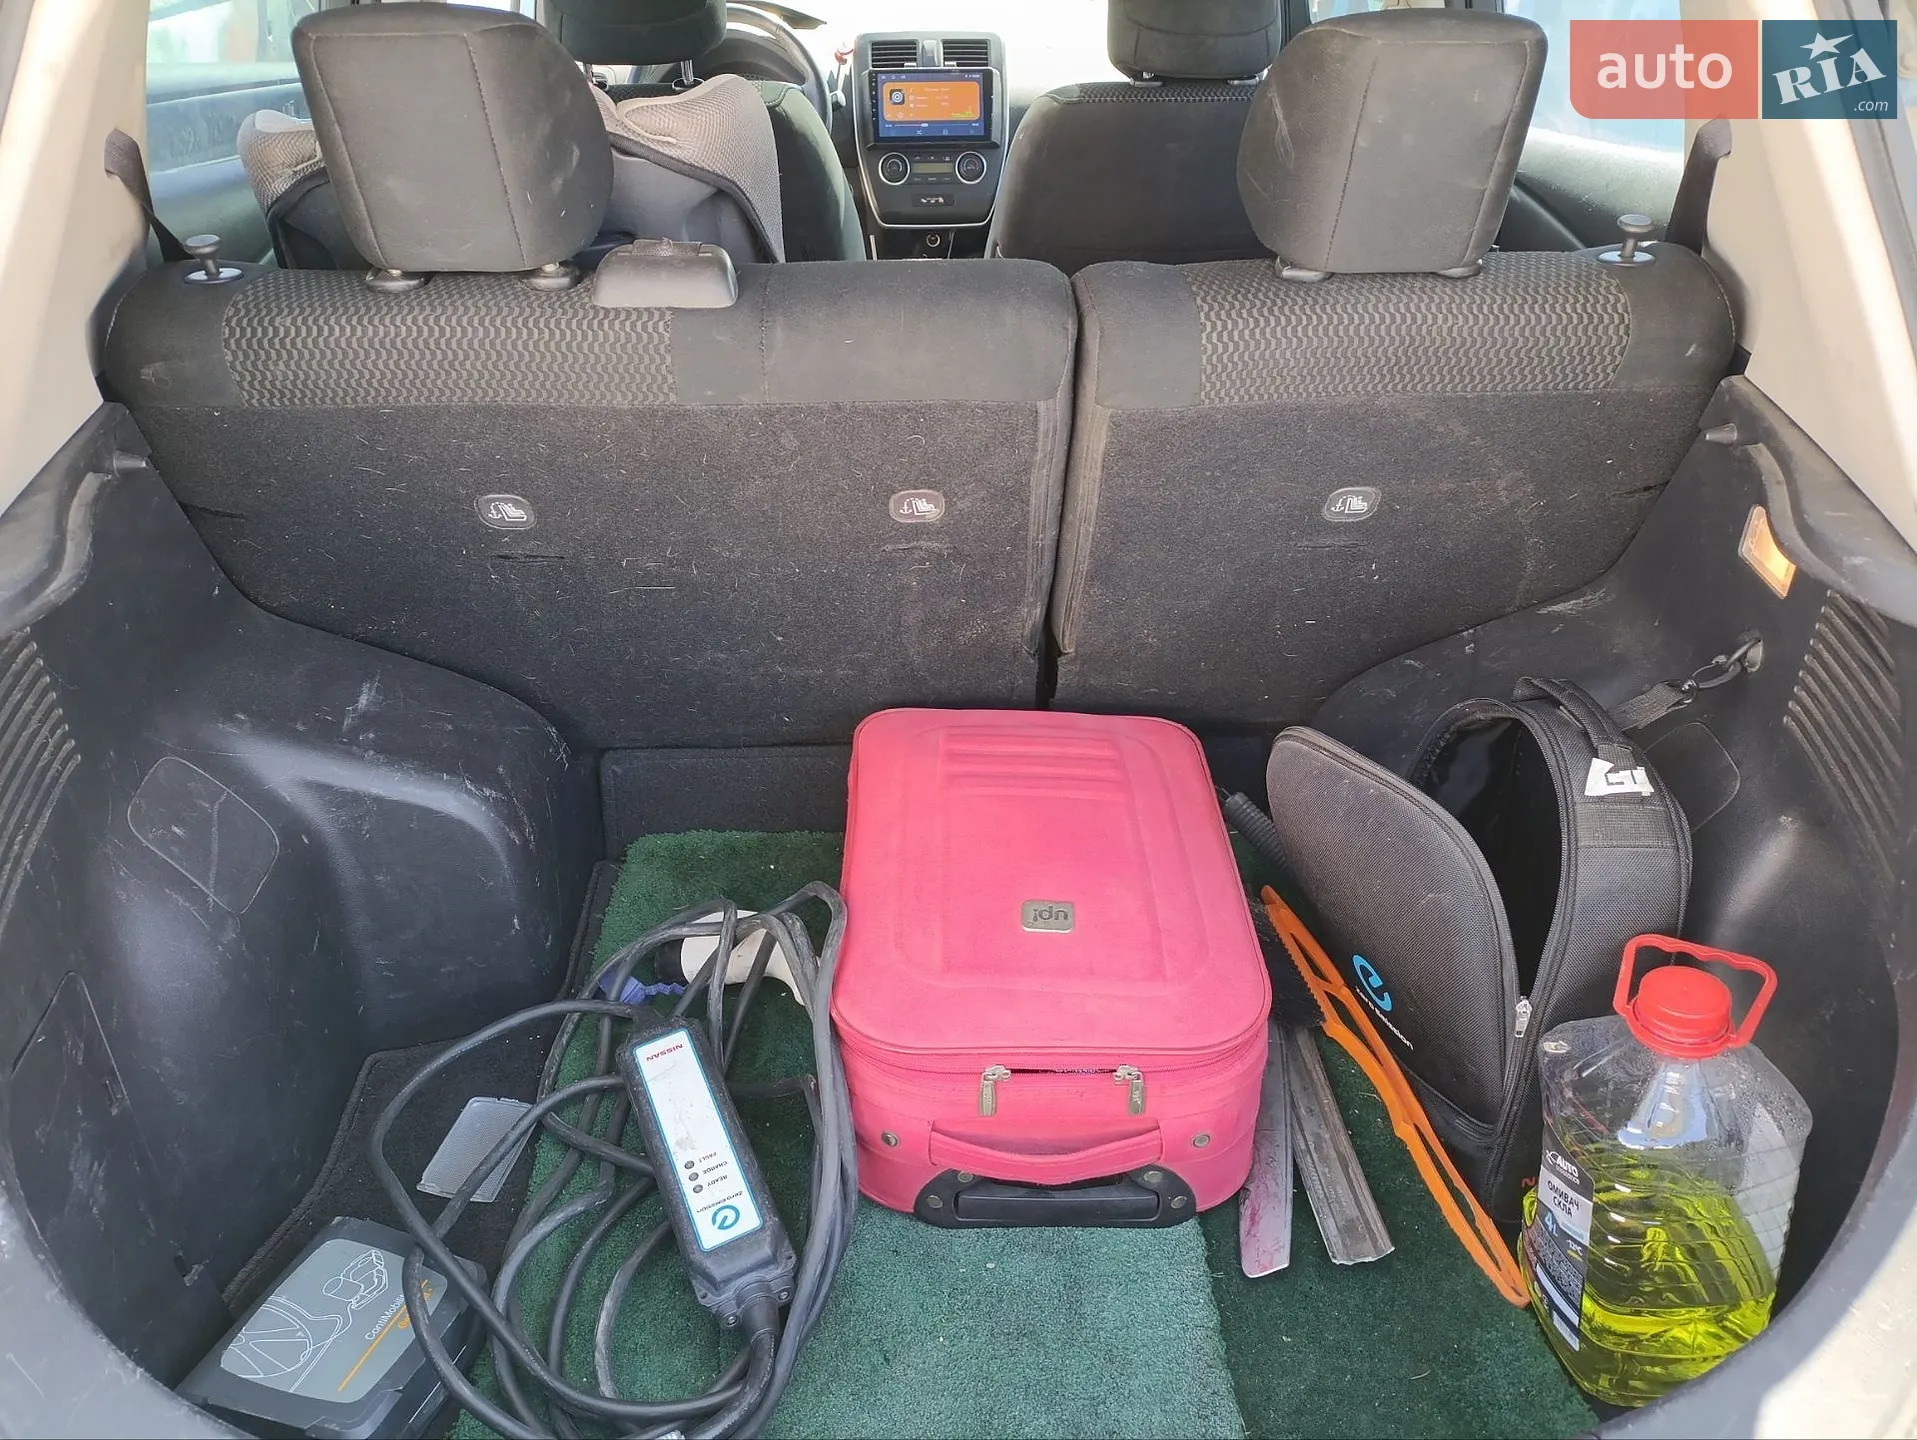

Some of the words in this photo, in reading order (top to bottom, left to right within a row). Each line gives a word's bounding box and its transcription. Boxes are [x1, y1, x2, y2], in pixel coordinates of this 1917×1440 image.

[646, 1043, 683, 1062] NISSAN
[702, 1160, 728, 1174] CHARGE
[707, 1174, 728, 1187] READY
[1547, 1180, 1580, 1211] ОМИВАЧ
[1552, 1196, 1573, 1218] СКЛА
